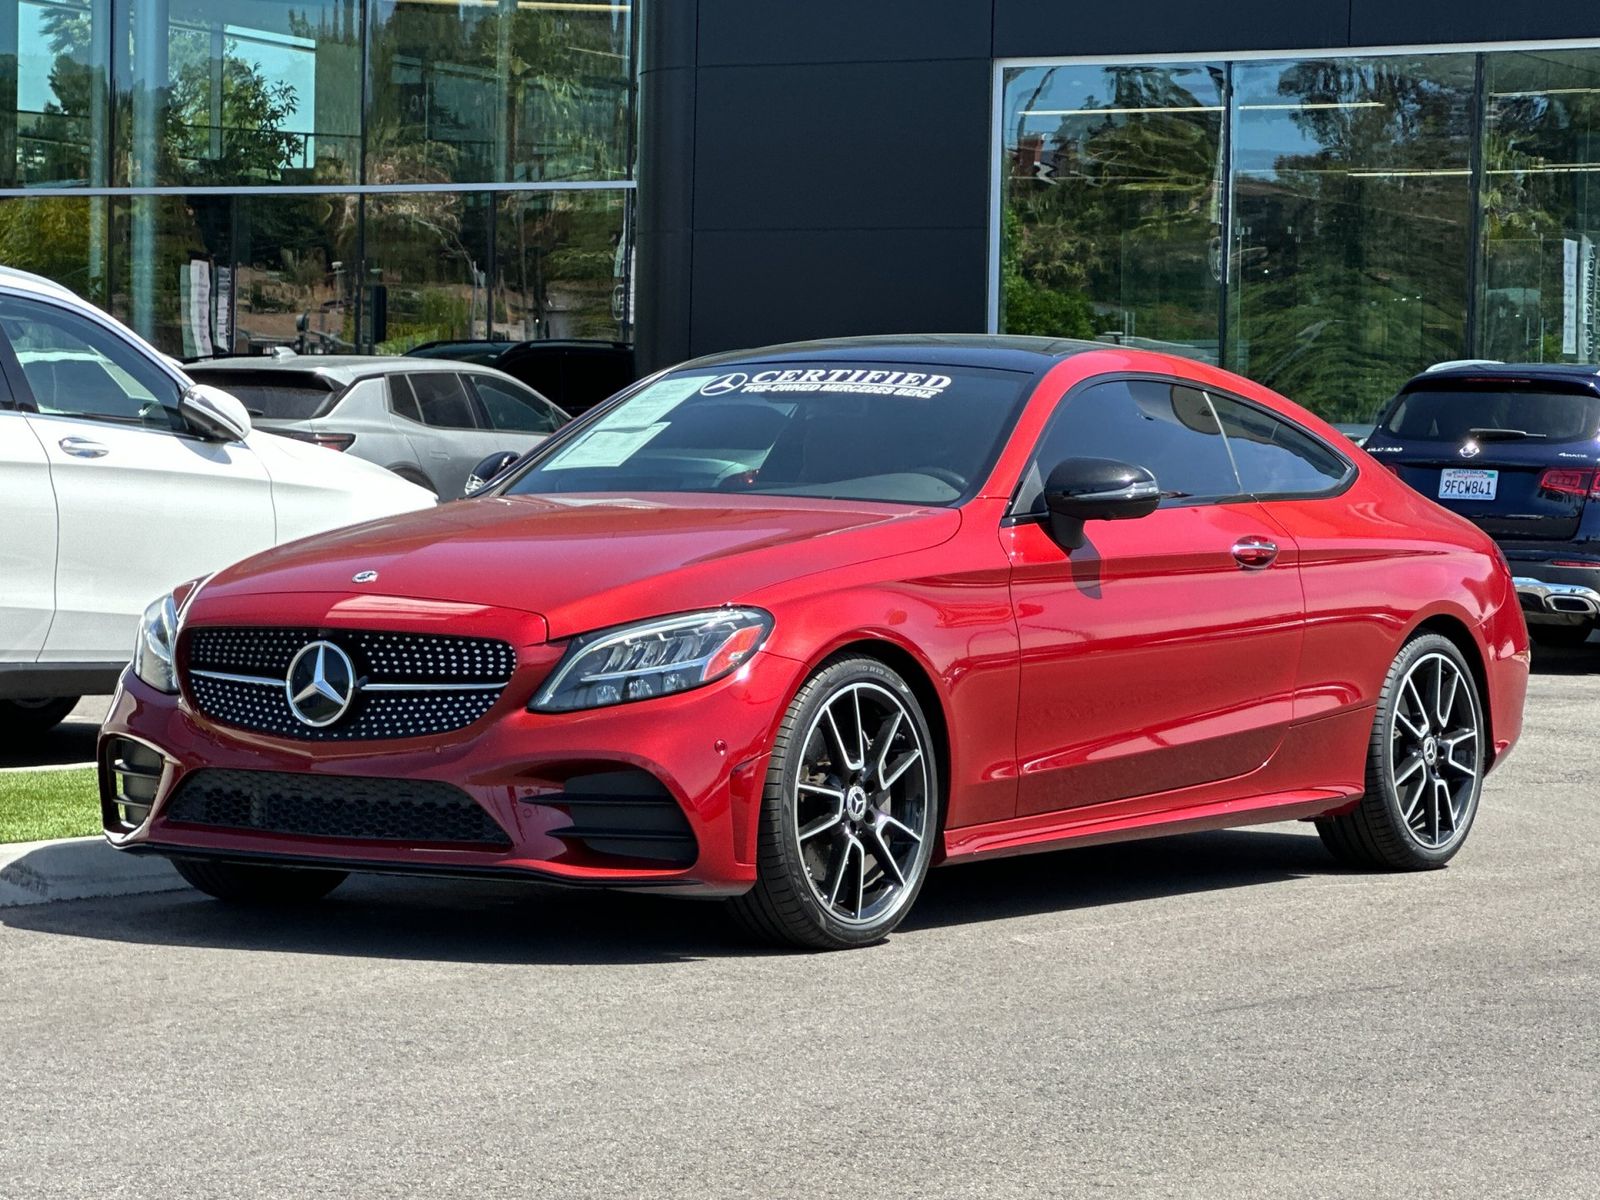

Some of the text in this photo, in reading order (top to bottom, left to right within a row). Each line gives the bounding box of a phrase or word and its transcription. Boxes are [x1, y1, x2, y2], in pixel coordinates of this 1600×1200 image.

[751, 369, 952, 389] CERTIFIED
[740, 383, 938, 399] PRE-OWNED MERCEDES BENZ
[1444, 480, 1492, 495] 9FCW841
